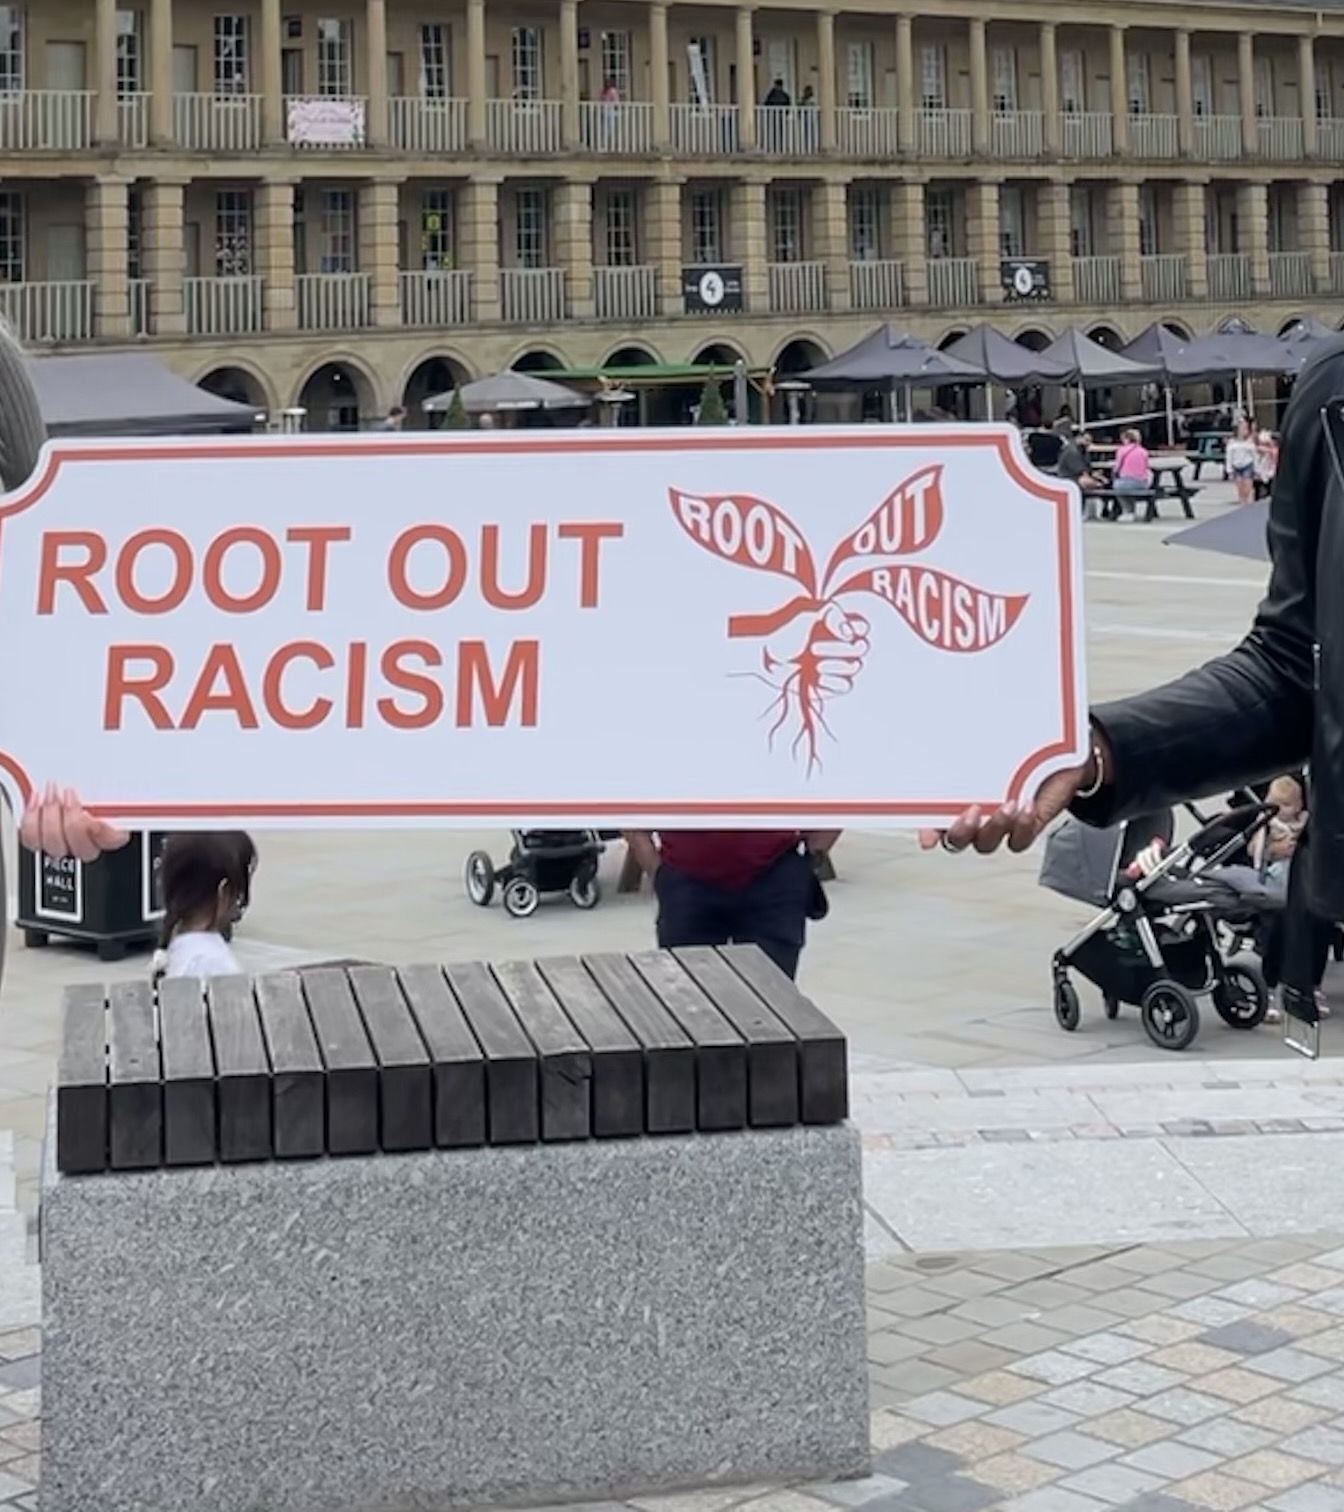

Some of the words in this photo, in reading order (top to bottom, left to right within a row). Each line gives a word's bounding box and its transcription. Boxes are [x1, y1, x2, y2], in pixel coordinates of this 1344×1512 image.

[678, 495, 804, 574] ROOT
[853, 472, 938, 554] OUT
[38, 525, 348, 612] ROOT
[388, 523, 622, 609] OUT
[872, 569, 1006, 649] RACISM
[106, 639, 539, 729] RACISM
